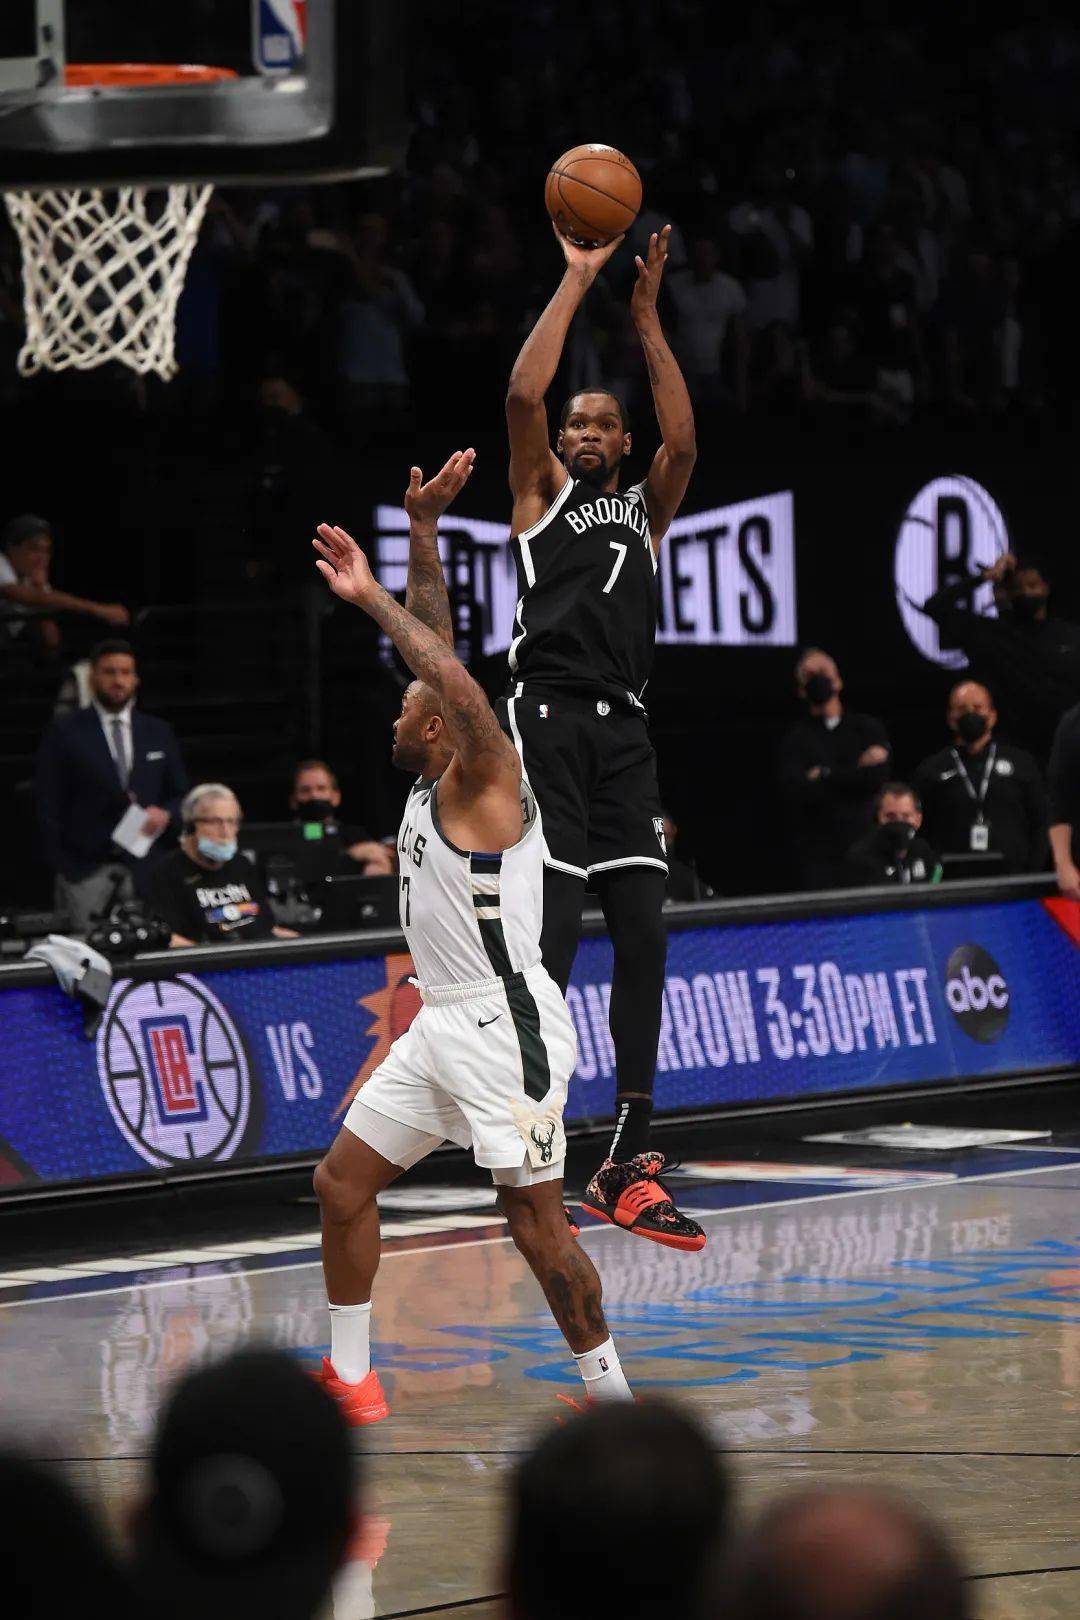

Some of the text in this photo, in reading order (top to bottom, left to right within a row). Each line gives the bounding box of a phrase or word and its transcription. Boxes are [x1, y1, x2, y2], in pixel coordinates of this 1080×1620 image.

[603, 541, 628, 594] 7
[657, 515, 775, 635] ETS
[400, 876, 411, 927] 7
[895, 967, 936, 1046] ET
[945, 965, 1009, 1013] abc
[265, 1021, 323, 1101] VS
